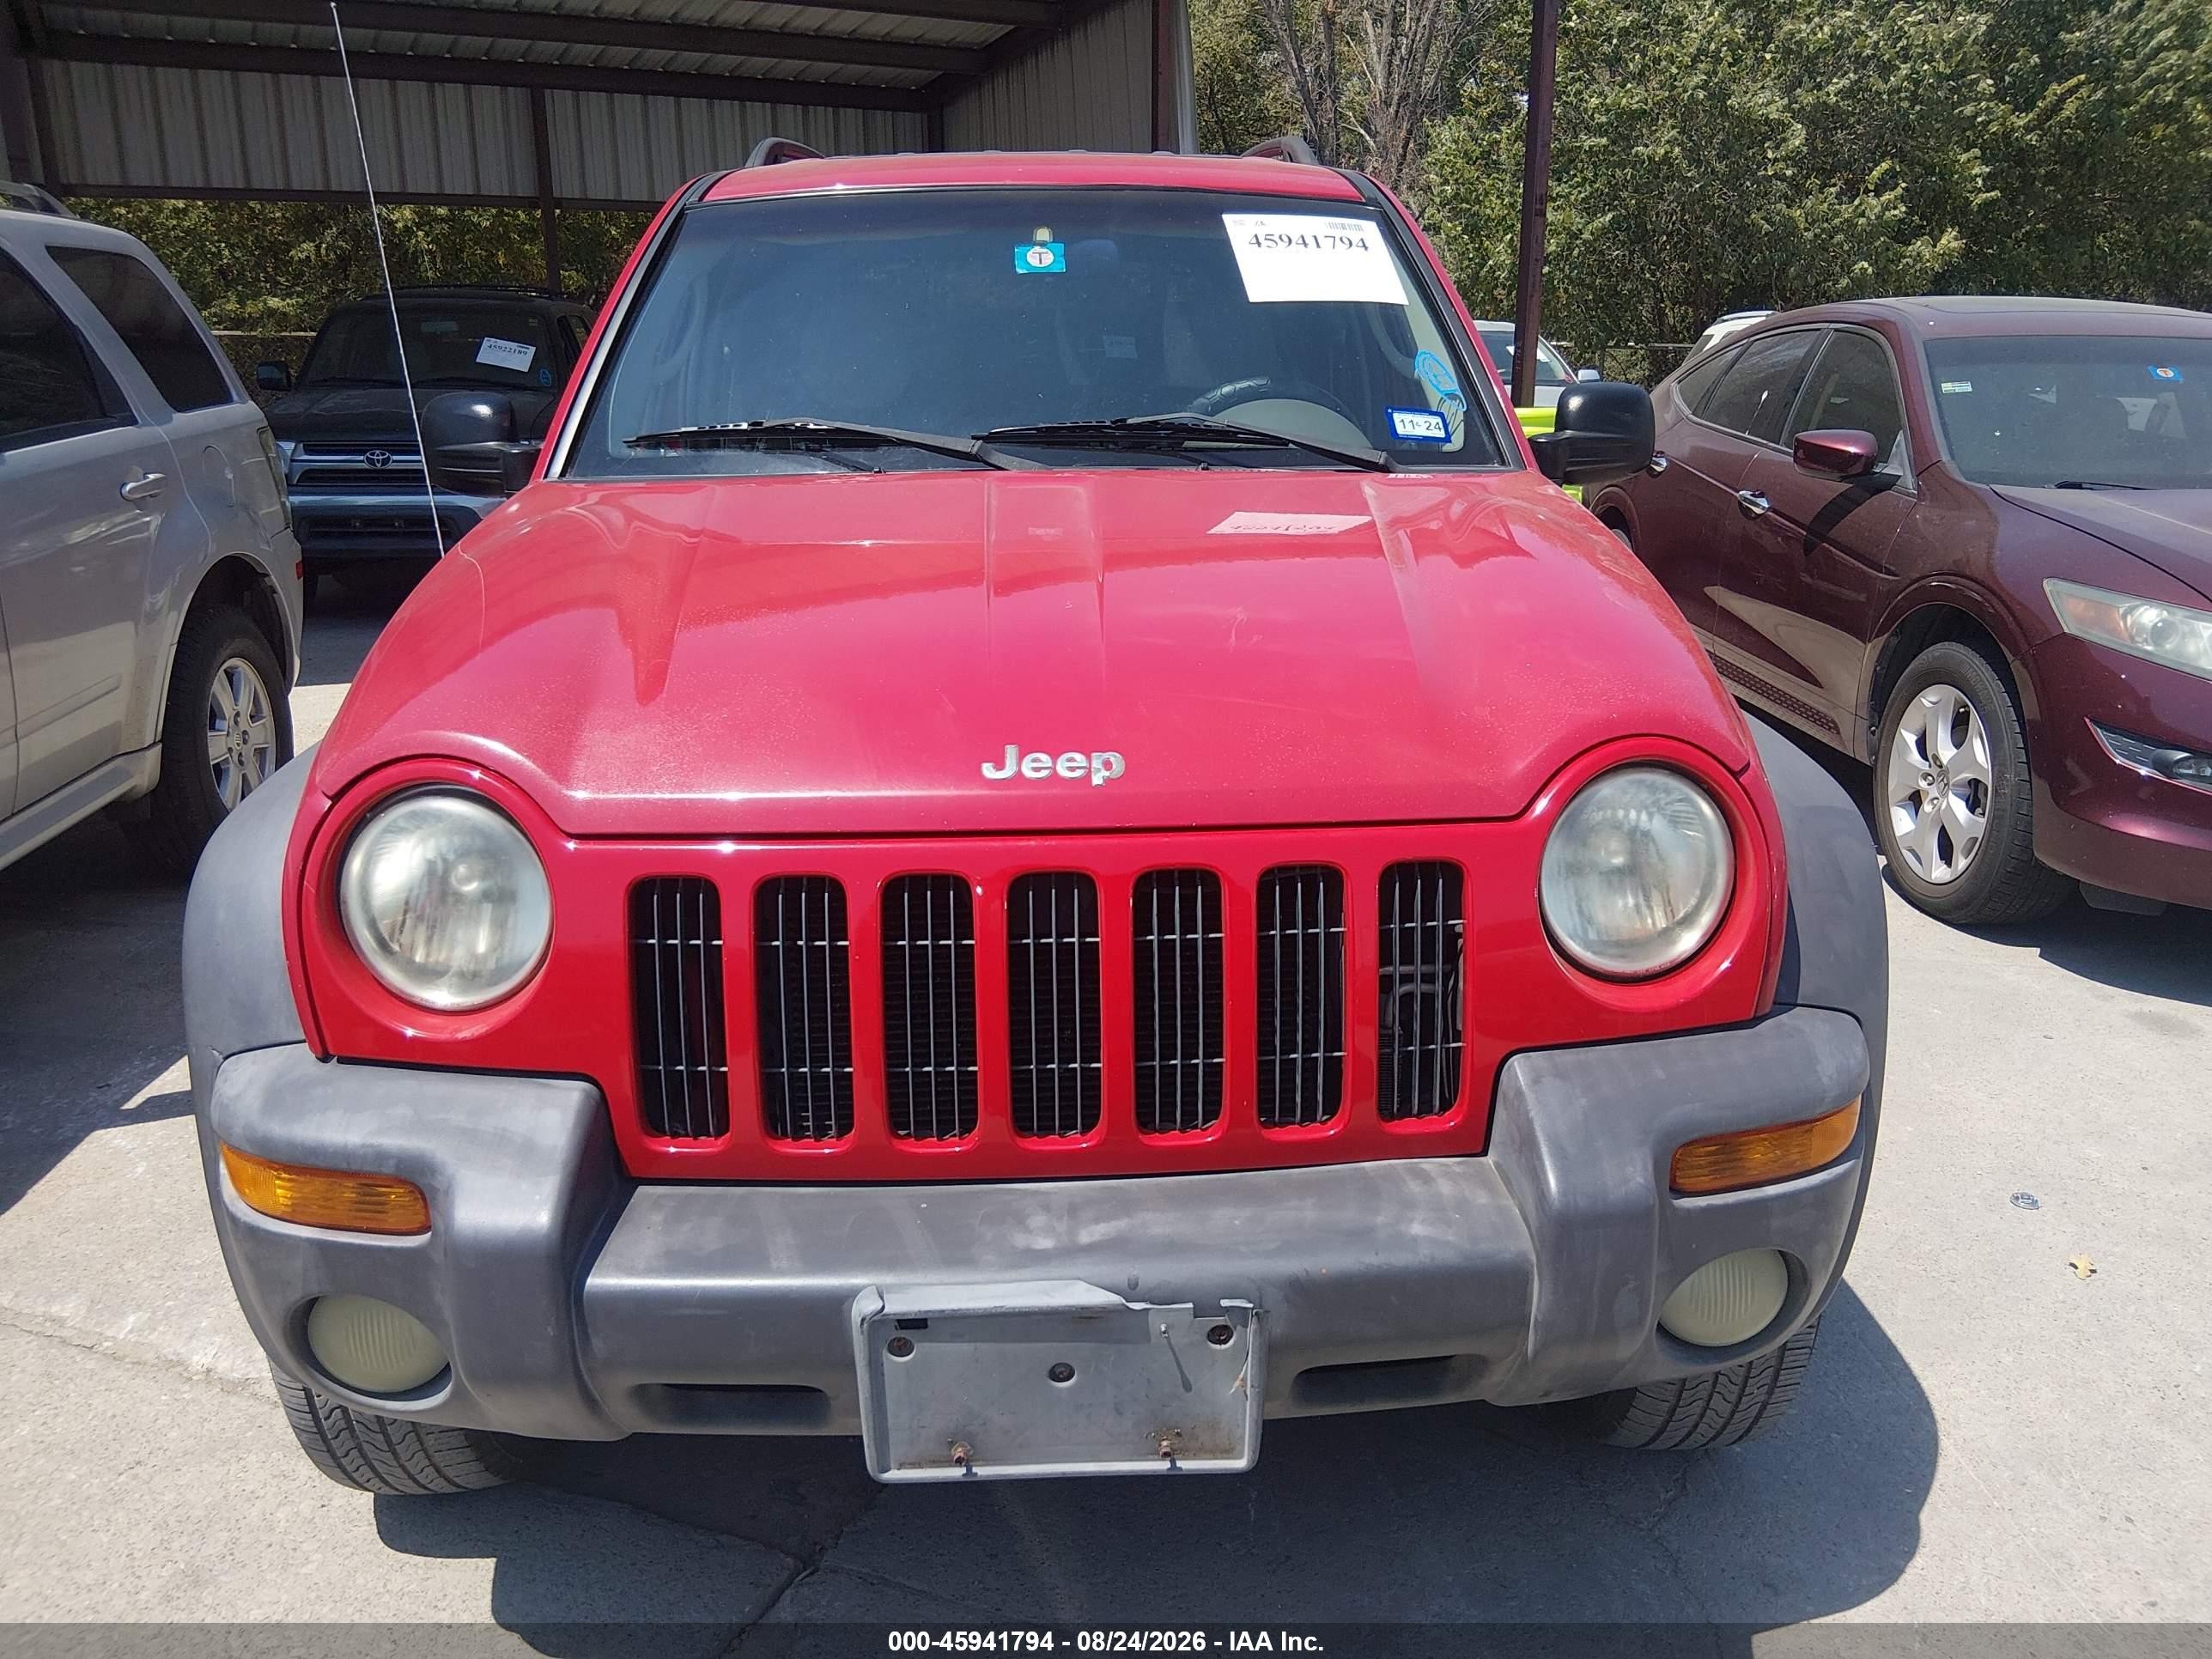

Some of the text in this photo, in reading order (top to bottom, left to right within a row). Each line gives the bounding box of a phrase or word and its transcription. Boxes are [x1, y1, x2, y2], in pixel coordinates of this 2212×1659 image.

[1249, 233, 1369, 252] 45941794
[1032, 252, 1048, 264] T
[487, 343, 528, 356] 45922189
[981, 744, 1126, 786] Jeep
